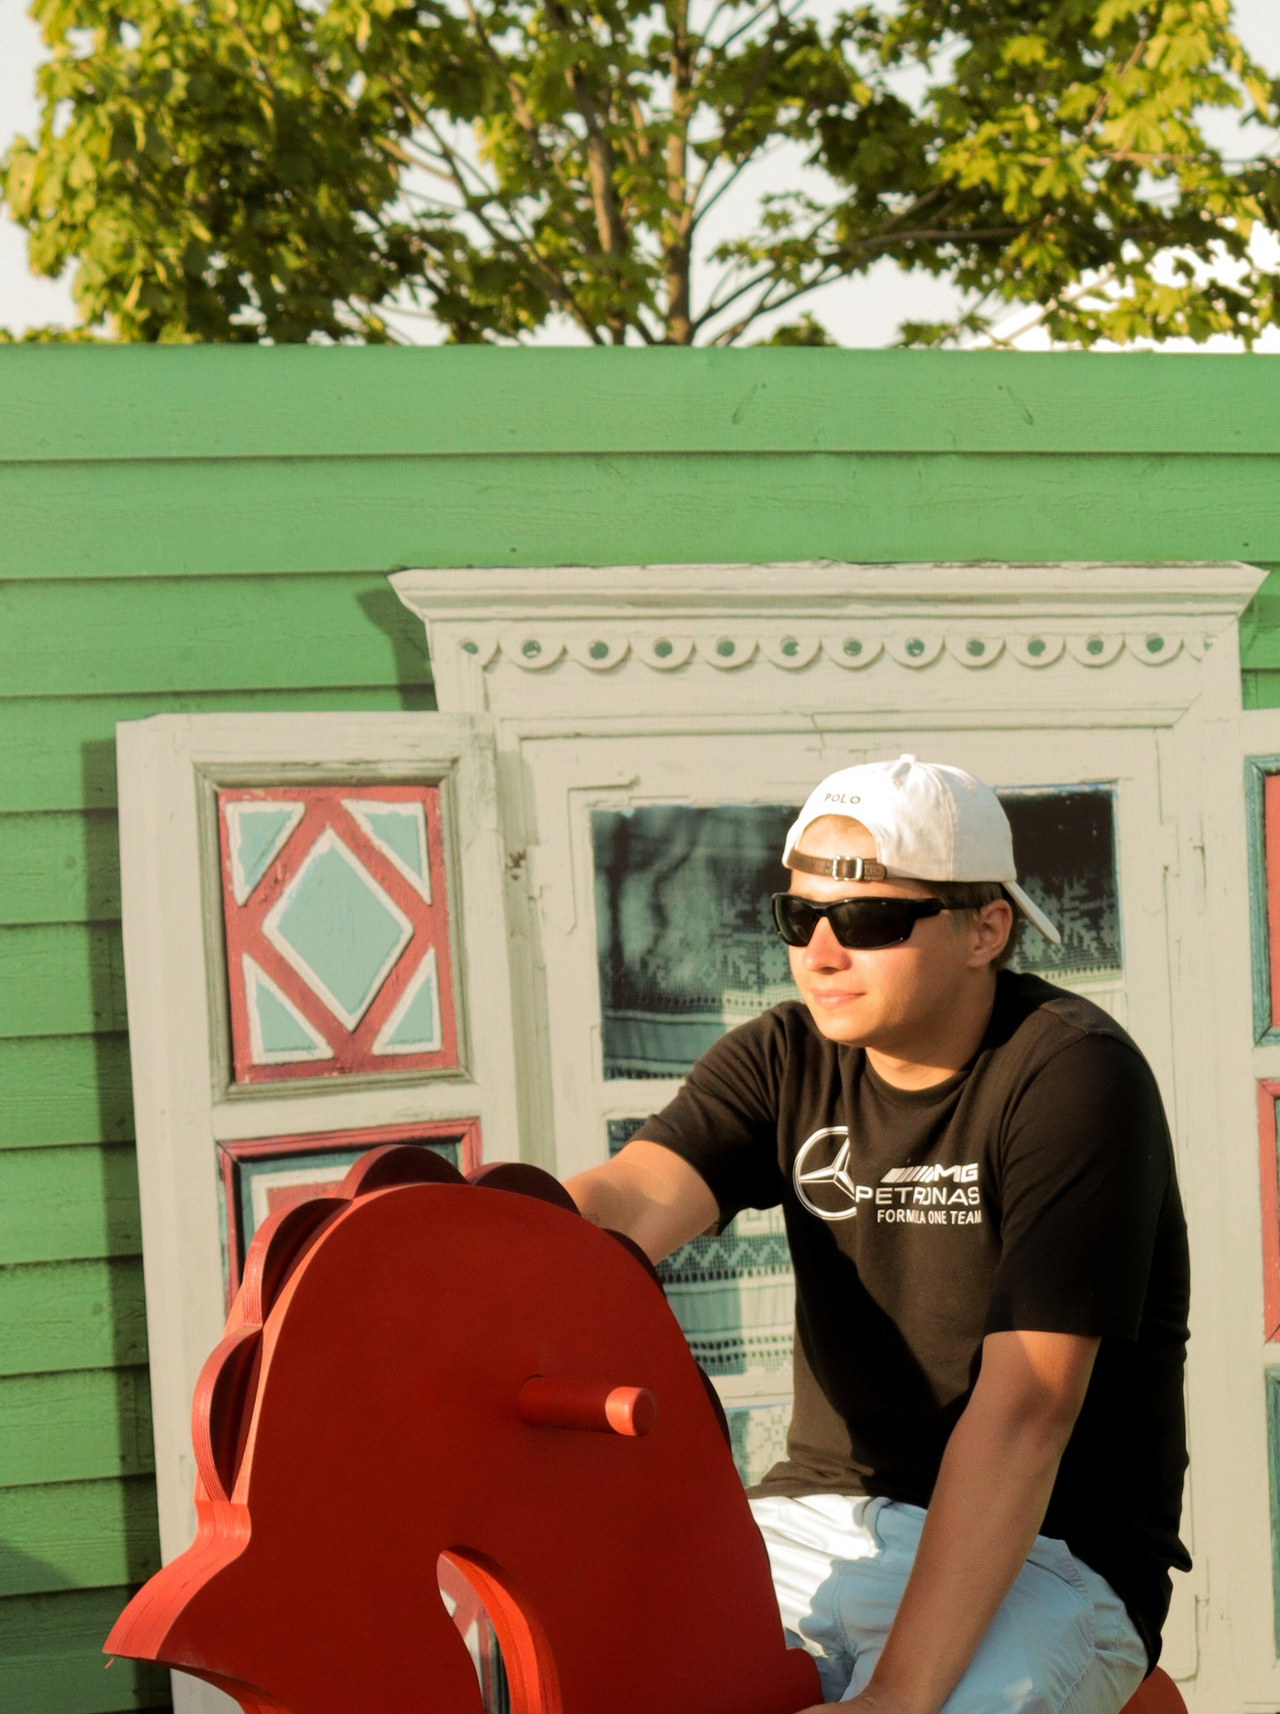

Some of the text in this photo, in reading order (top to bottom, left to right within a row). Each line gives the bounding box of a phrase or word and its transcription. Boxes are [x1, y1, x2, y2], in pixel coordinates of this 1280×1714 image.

[824, 793, 861, 805] POLO
[928, 1210, 947, 1225] ONE
[950, 1209, 982, 1225] TEAM
